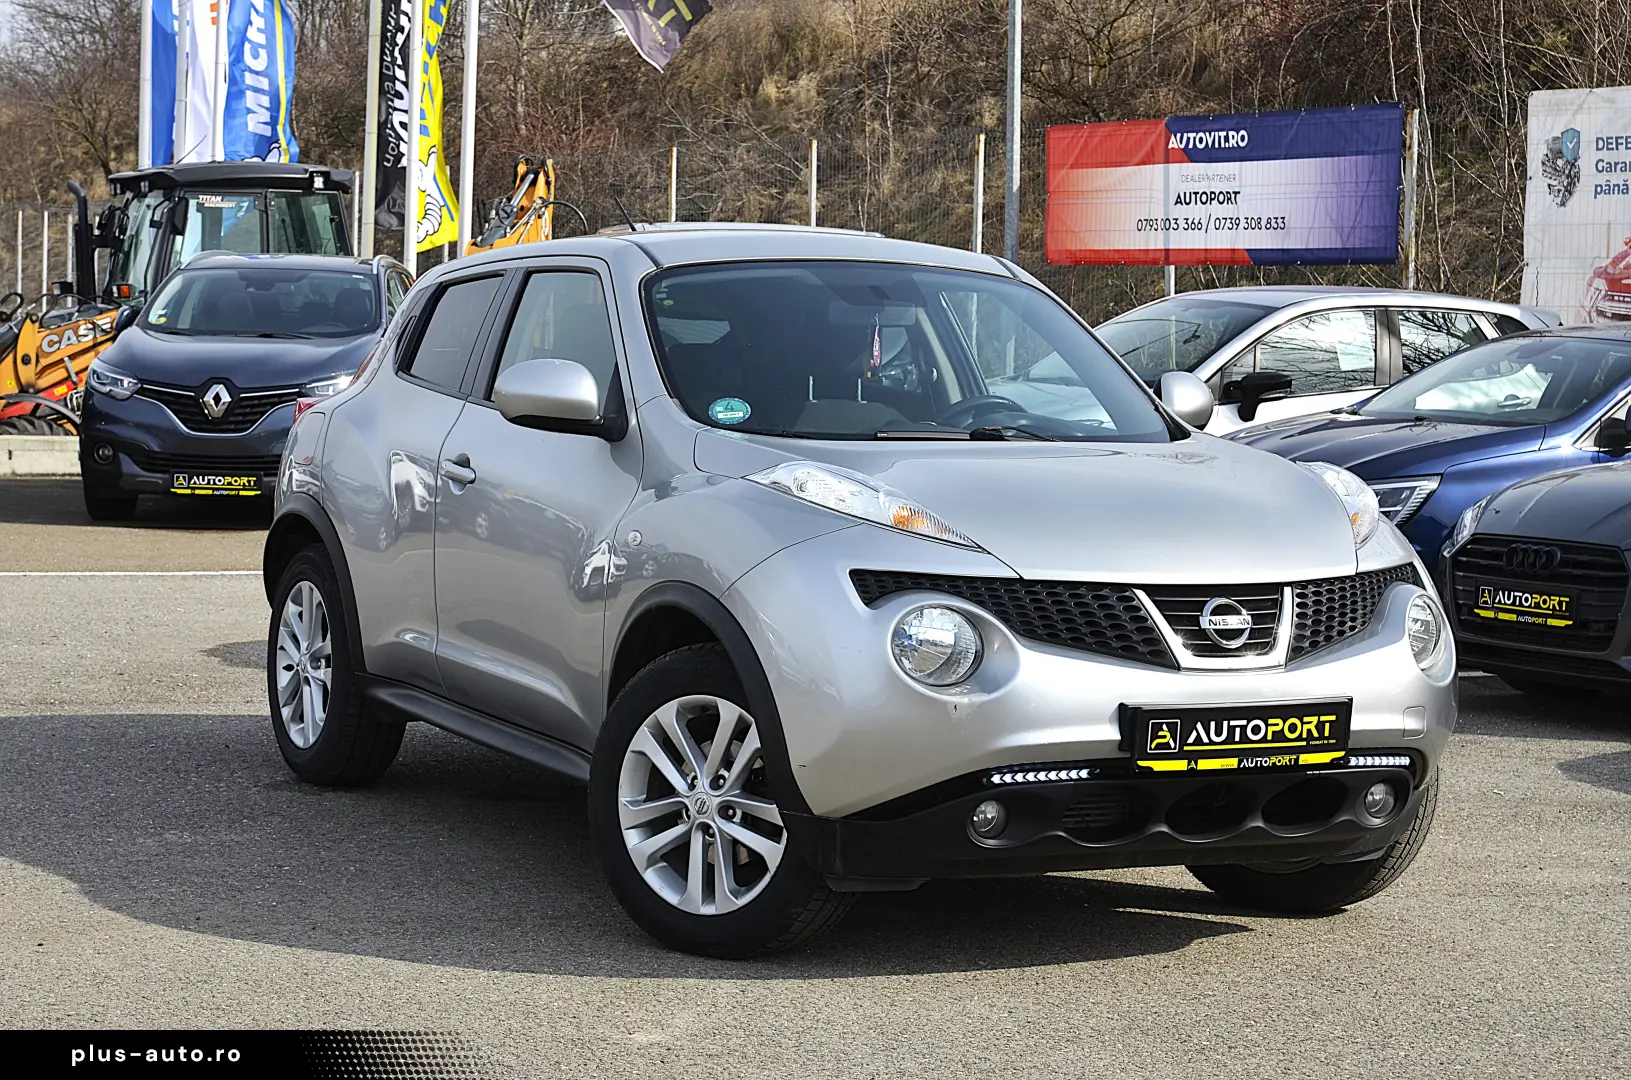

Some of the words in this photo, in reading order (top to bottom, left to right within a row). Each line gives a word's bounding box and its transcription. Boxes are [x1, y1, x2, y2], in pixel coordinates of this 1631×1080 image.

[1167, 129, 1249, 150] AUTOVIT.RO
[1595, 158, 1631, 173] Gara
[1594, 178, 1630, 199] până
[198, 194, 223, 202] TITAN
[1174, 190, 1241, 206] AUTOPORT
[1182, 217, 1203, 231] 366
[1214, 217, 1241, 231] 0739
[1243, 216, 1262, 231] 308
[1265, 216, 1286, 231] 833
[190, 475, 257, 486] AUTOPORT
[1494, 589, 1570, 611] AUTOPORT
[1208, 617, 1251, 627] NISAN
[1186, 715, 1337, 744] AUTOPORT
[1239, 755, 1297, 768] AUTOPORT
